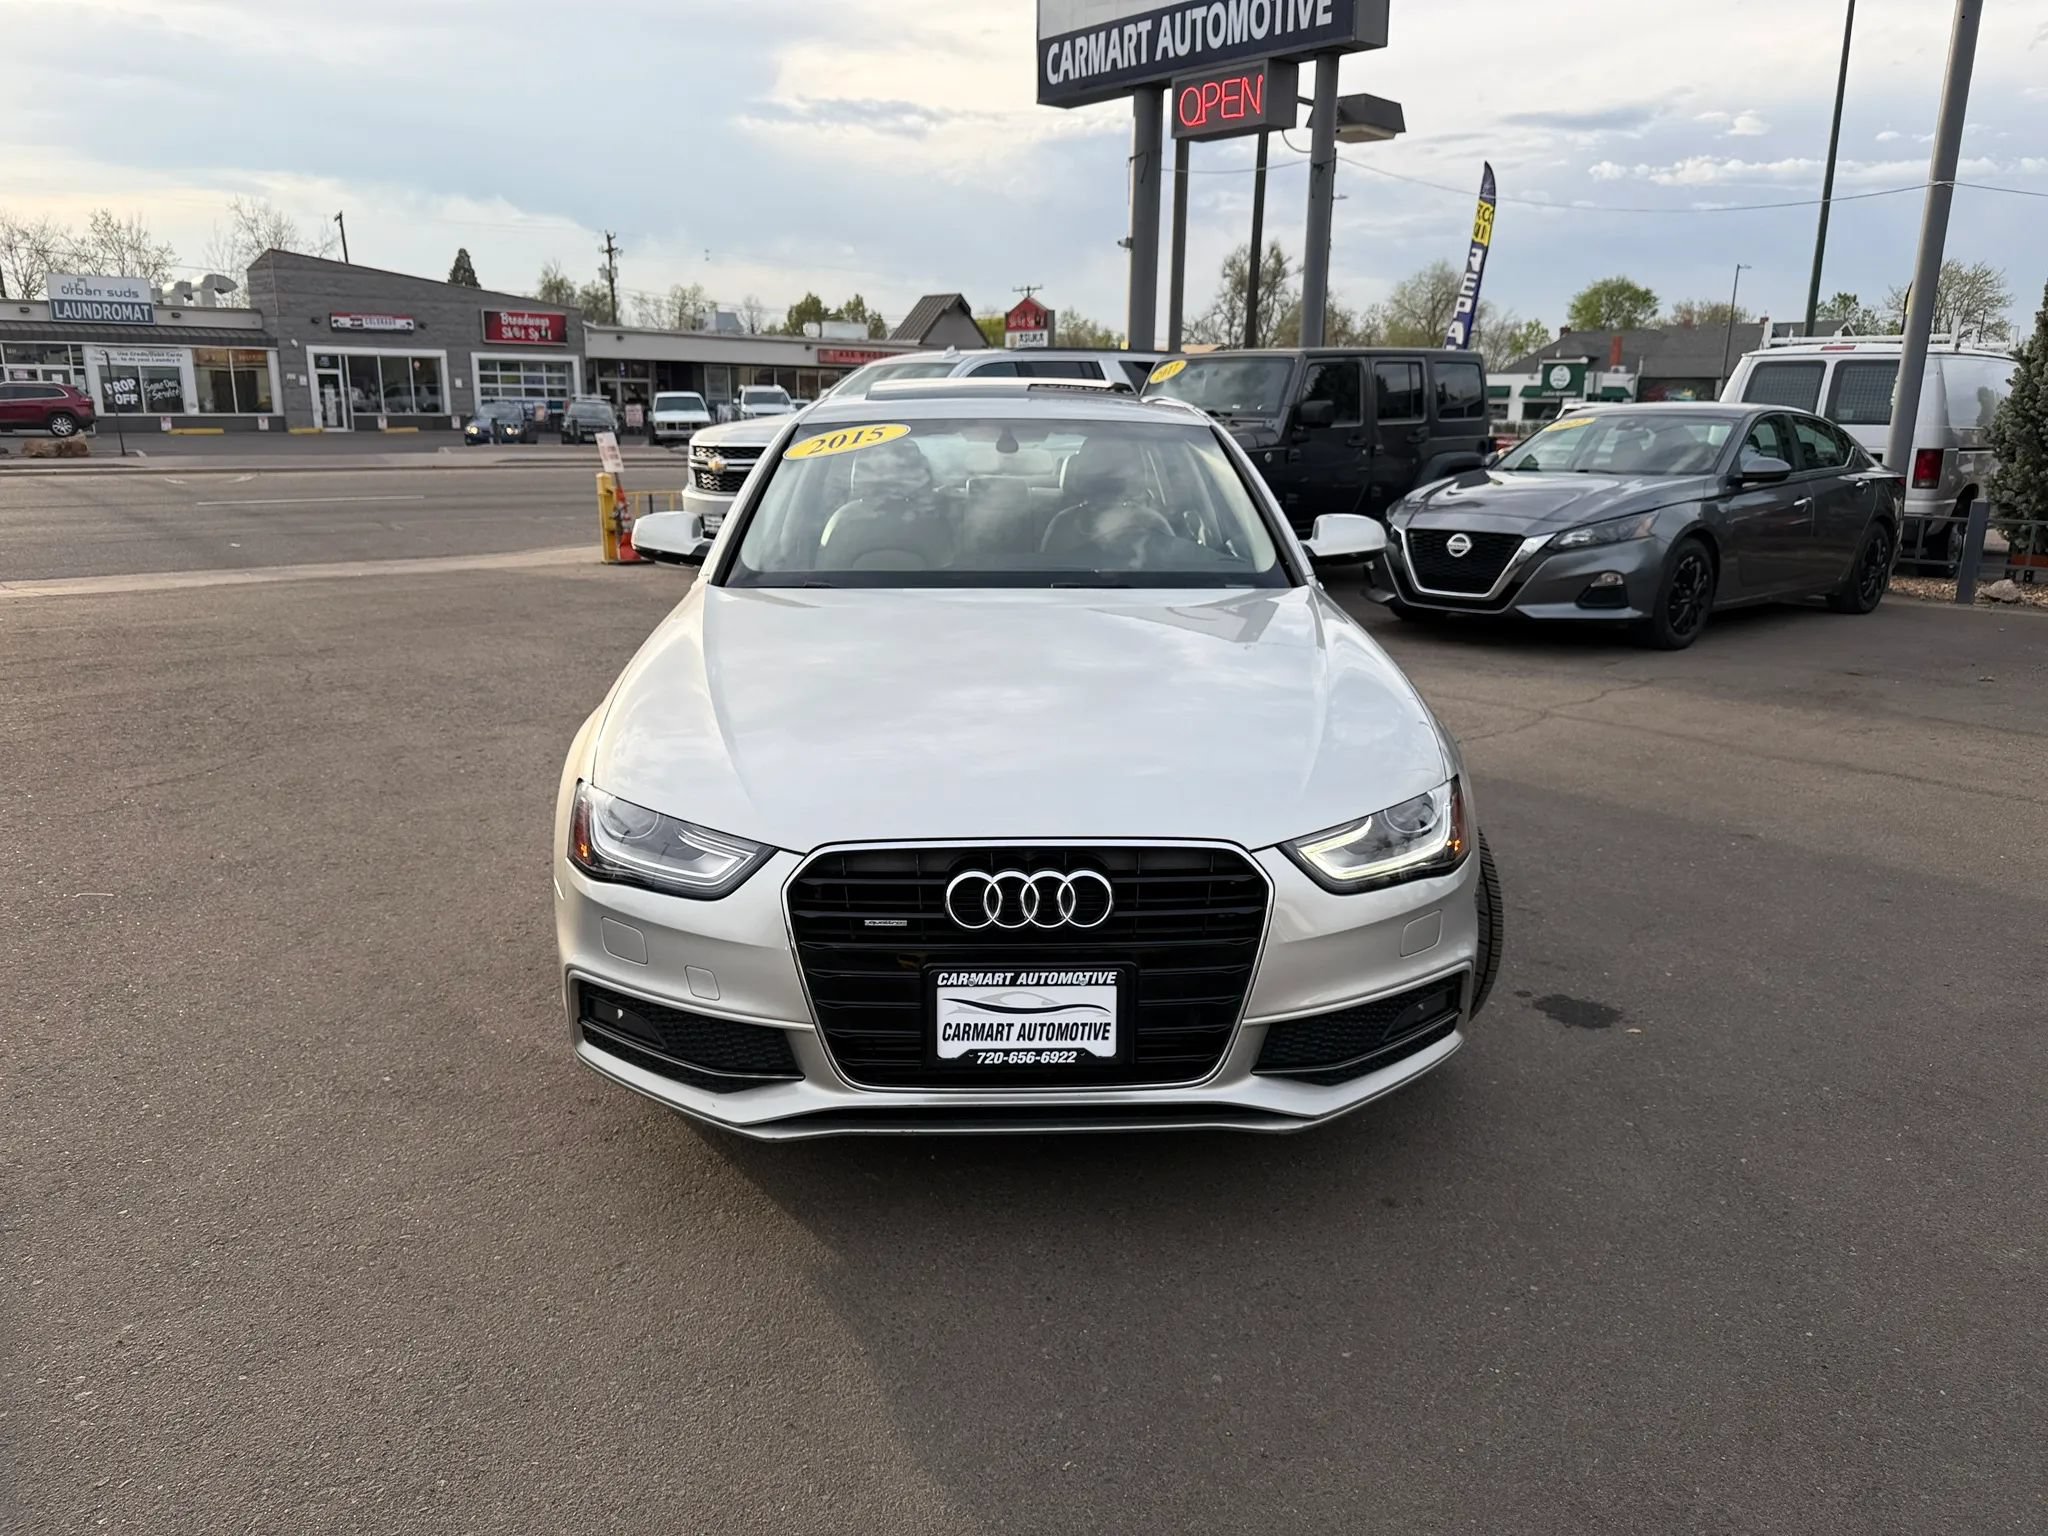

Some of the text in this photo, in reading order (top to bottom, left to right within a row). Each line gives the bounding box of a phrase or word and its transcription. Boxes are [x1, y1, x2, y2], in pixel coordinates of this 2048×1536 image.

[1046, 0, 1333, 85] CARMART AUTOMOTIVE
[1179, 74, 1264, 127] OPEN
[54, 301, 150, 321] LAUNDROMAT
[104, 379, 136, 395] DROP
[114, 393, 138, 405] OFF
[808, 426, 886, 455] 2015
[937, 971, 1118, 986] CARMART AUTOMOTIVE
[942, 1021, 1112, 1042] CARMART AUTOMOTIVE
[976, 1051, 1078, 1065] 720-656-6922
